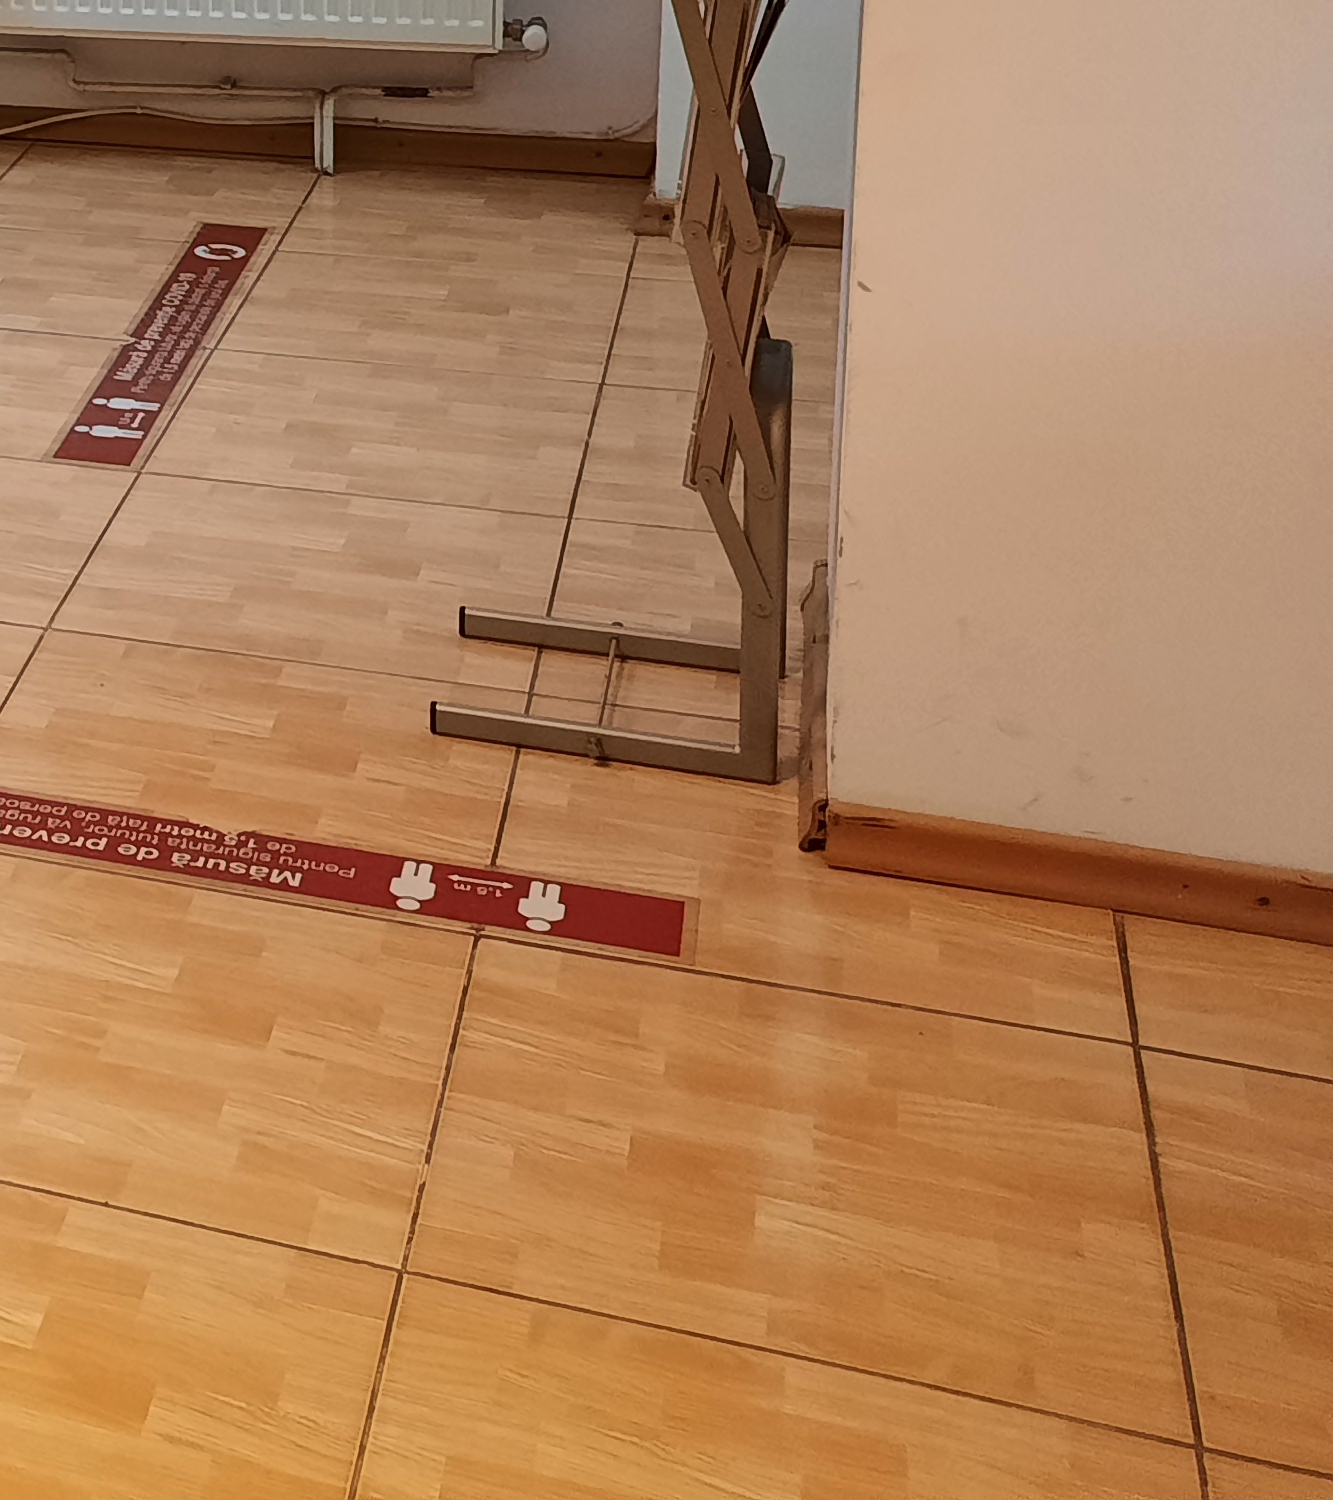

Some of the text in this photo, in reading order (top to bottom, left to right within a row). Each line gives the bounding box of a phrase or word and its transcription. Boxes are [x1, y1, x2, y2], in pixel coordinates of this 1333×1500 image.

[46, 816, 72, 830] vă
[72, 808, 102, 823] de
[81, 820, 160, 846] tuturor,
[154, 822, 219, 842] metri
[117, 843, 160, 862] de
[266, 841, 297, 854] de
[170, 852, 303, 888] Măsură
[278, 855, 357, 879] Pentru
